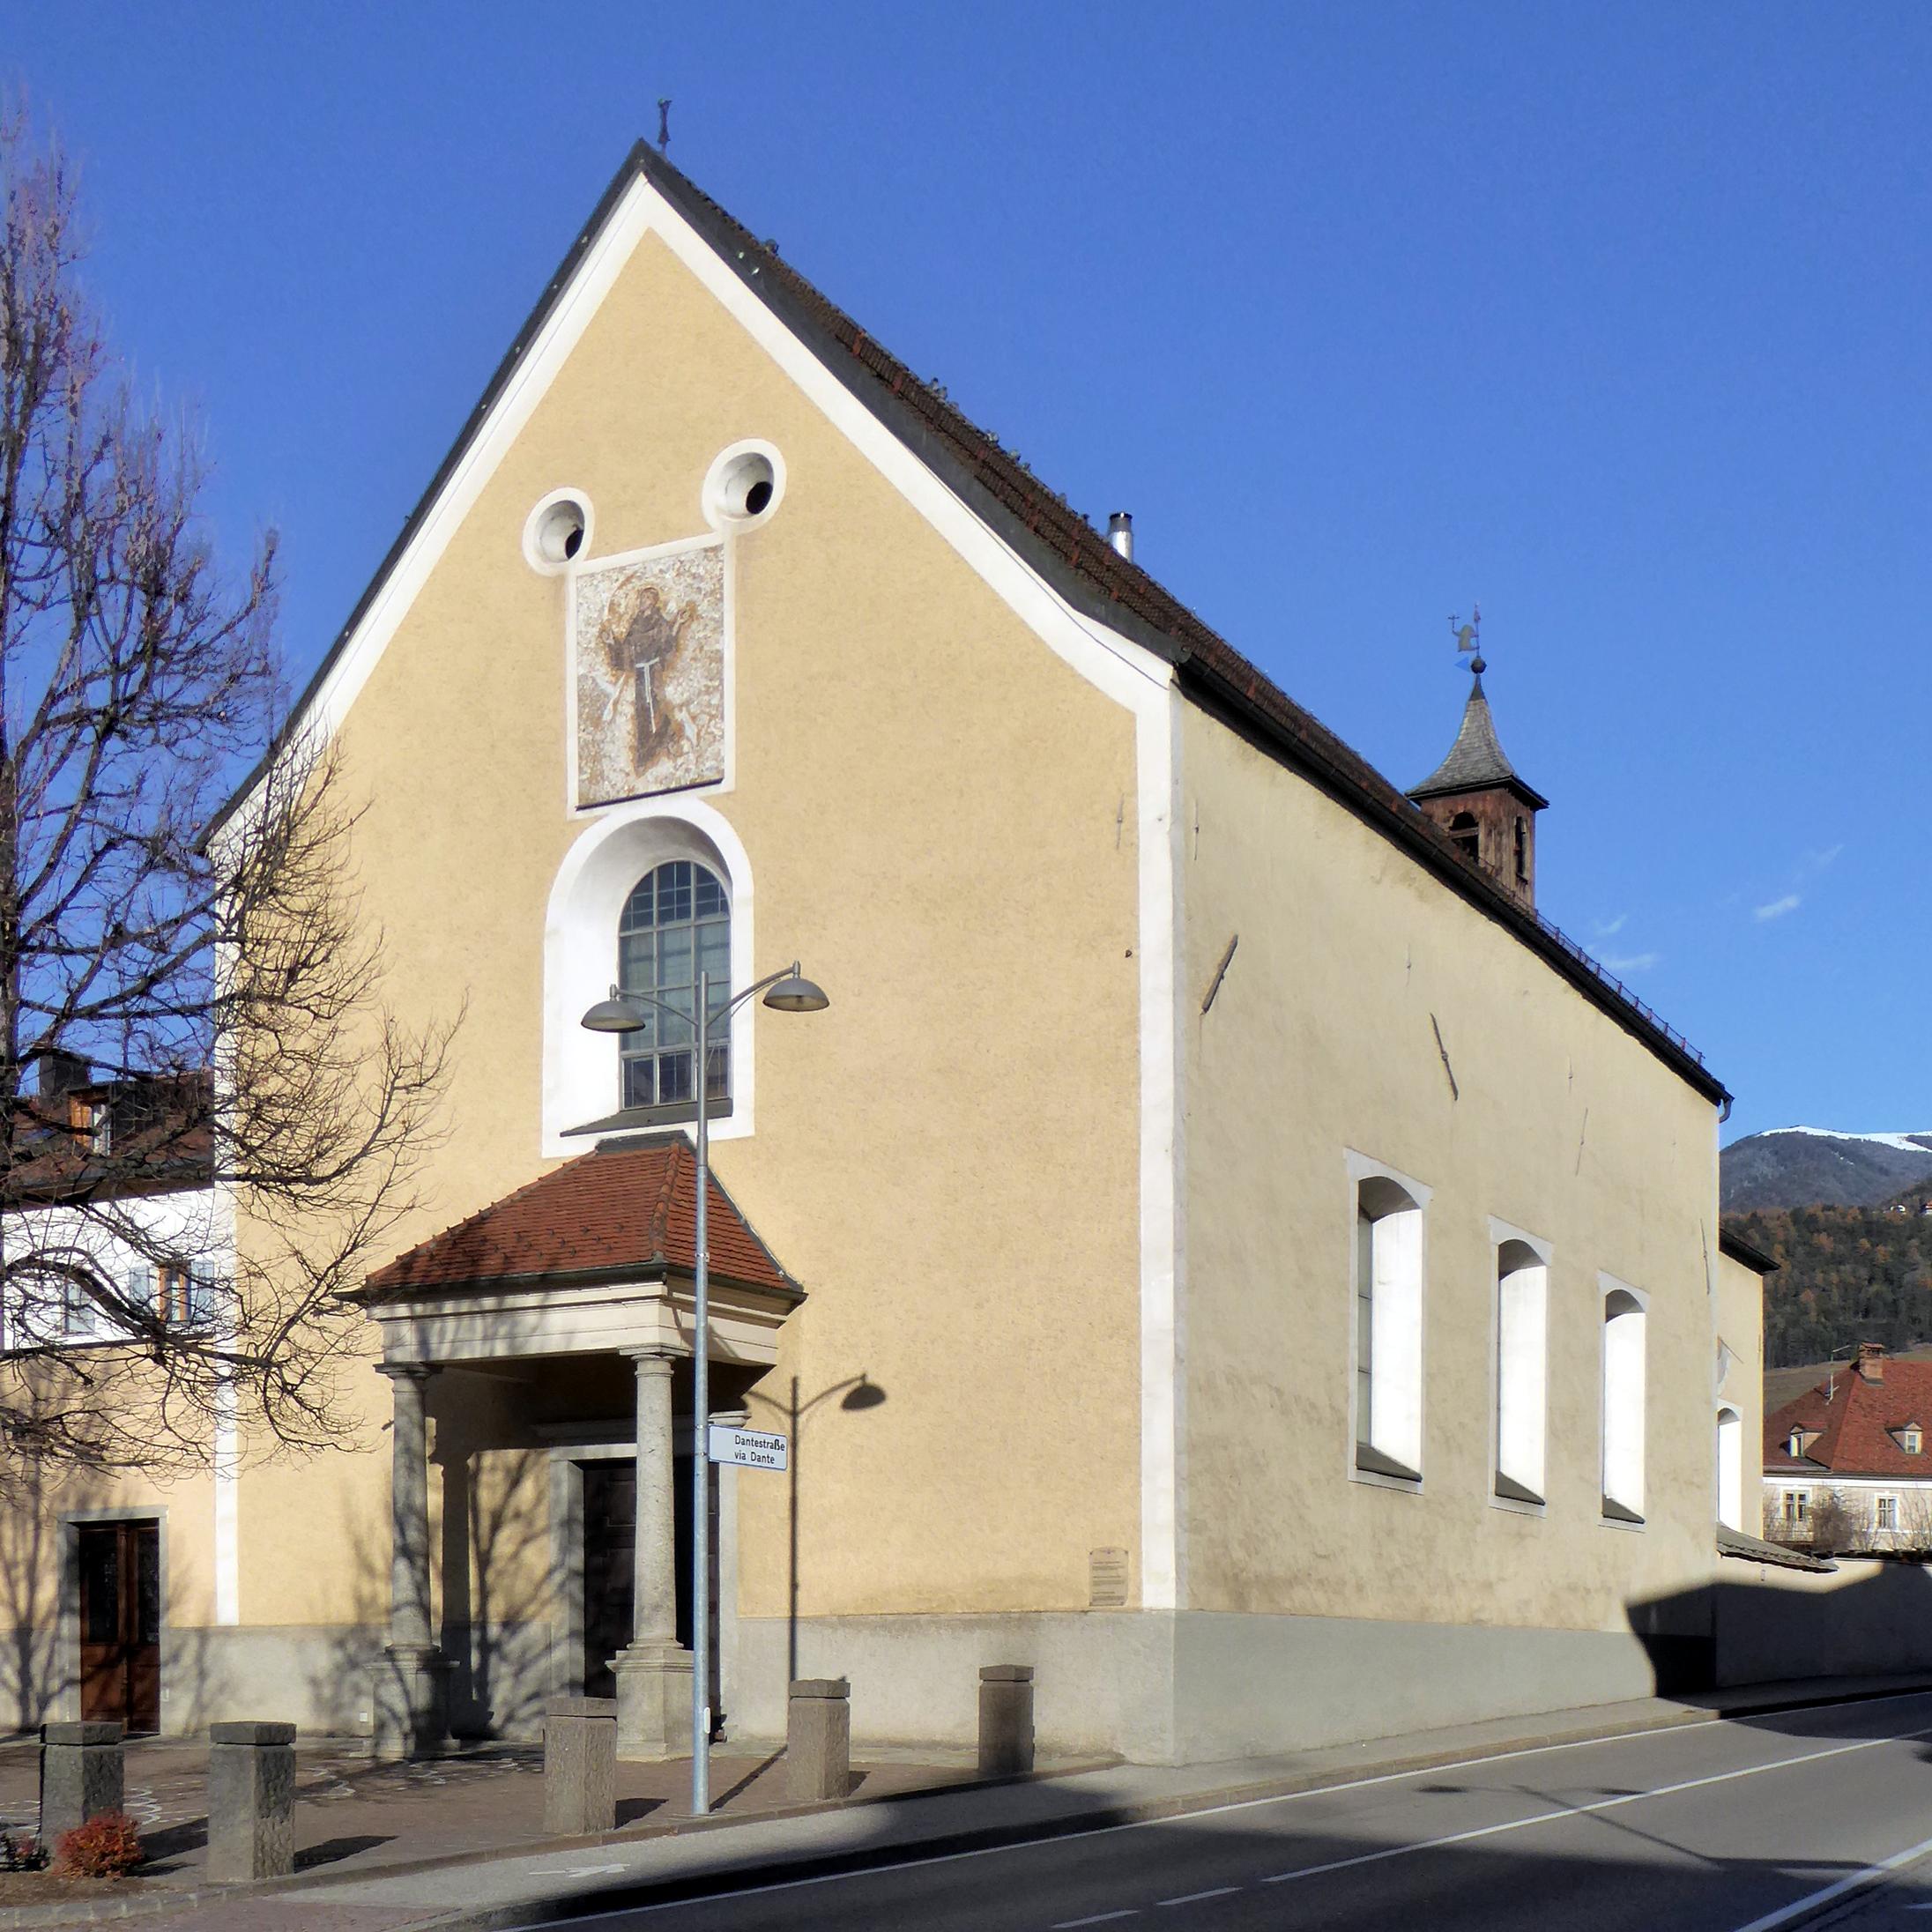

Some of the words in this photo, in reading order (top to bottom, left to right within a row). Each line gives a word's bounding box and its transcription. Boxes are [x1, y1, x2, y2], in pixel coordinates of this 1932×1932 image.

[734, 1434, 785, 1452] Dantestraße
[734, 1450, 747, 1460] via
[750, 1452, 776, 1464] Dante
